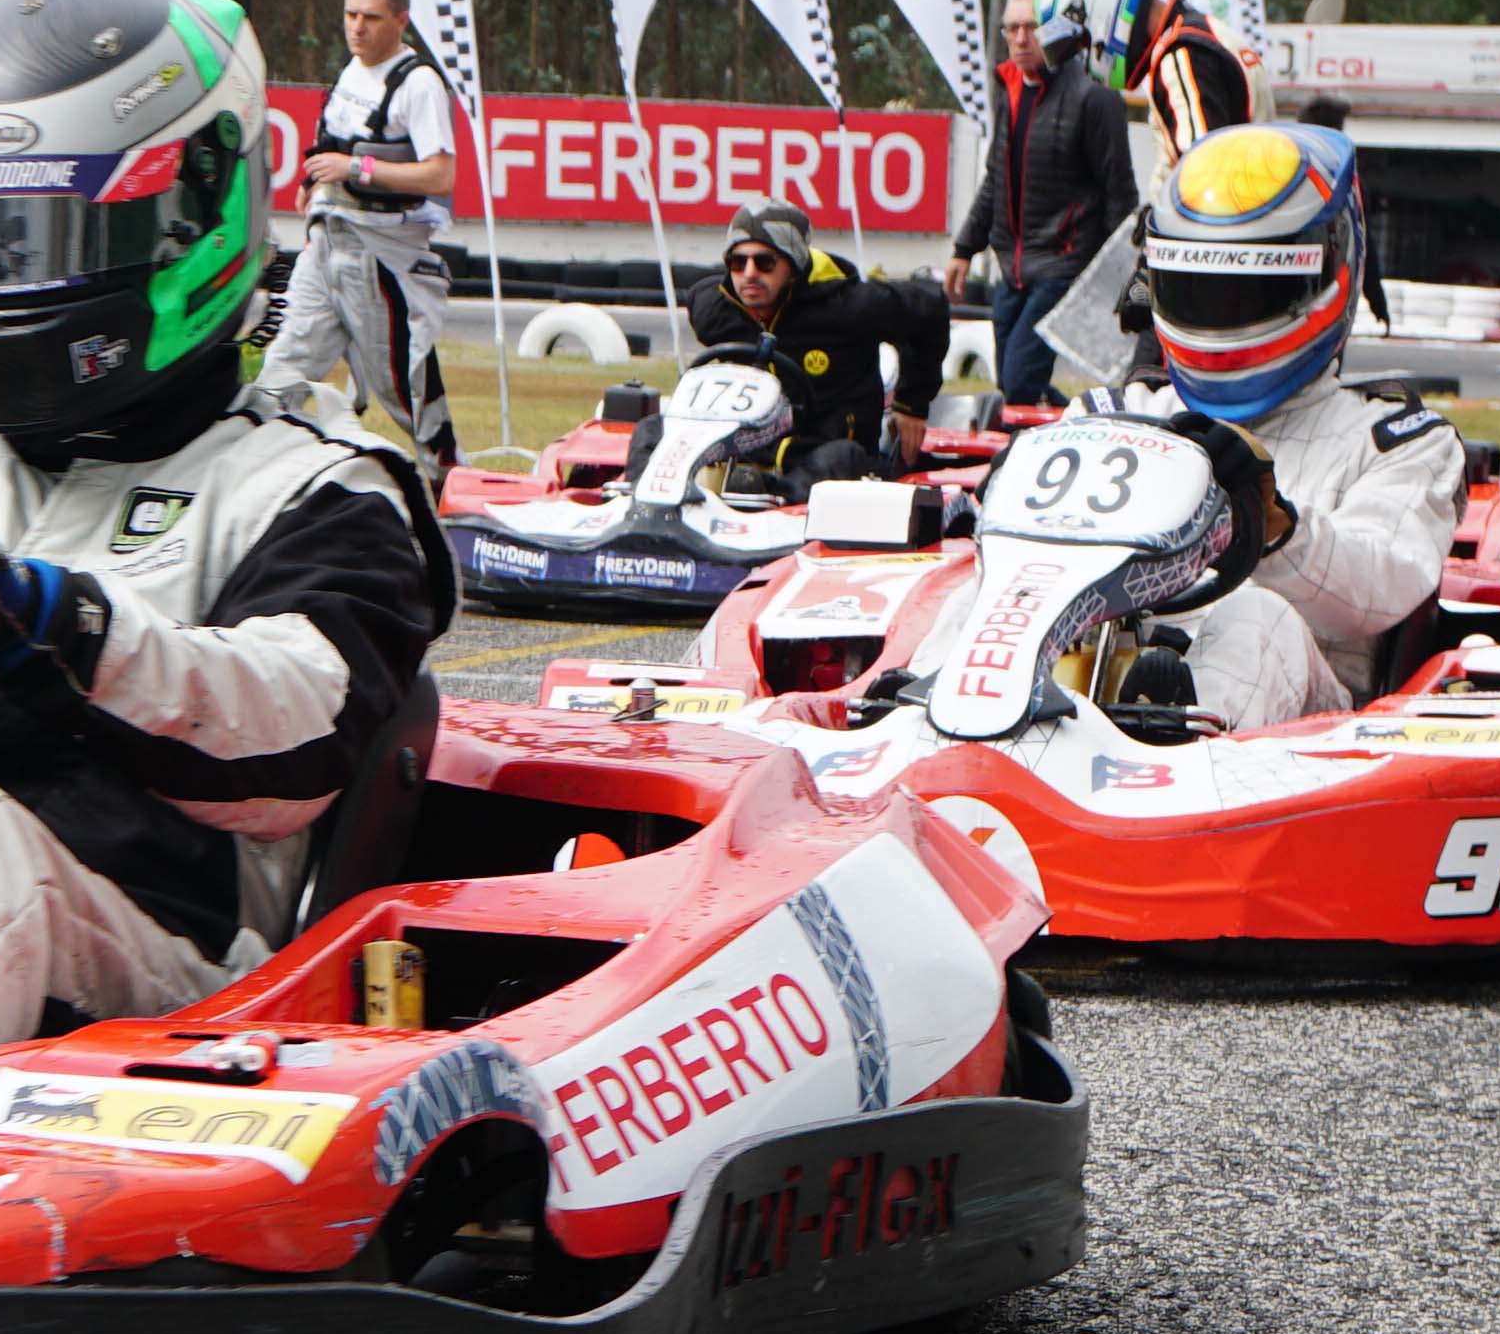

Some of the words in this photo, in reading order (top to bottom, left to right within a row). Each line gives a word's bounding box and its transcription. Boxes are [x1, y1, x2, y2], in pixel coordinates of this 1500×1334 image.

[489, 117, 925, 212] FERBERTO
[1156, 247, 1178, 261] NEW
[1182, 249, 1249, 266] KARTING
[689, 380, 758, 412] 175
[1033, 430, 1177, 456] EUROINDY
[1025, 447, 1139, 514] 93
[595, 554, 692, 578] FREZYDERM
[957, 563, 1065, 699] FERBERTO
[547, 971, 829, 1197] FERBERTO
[126, 1102, 309, 1151] eni
